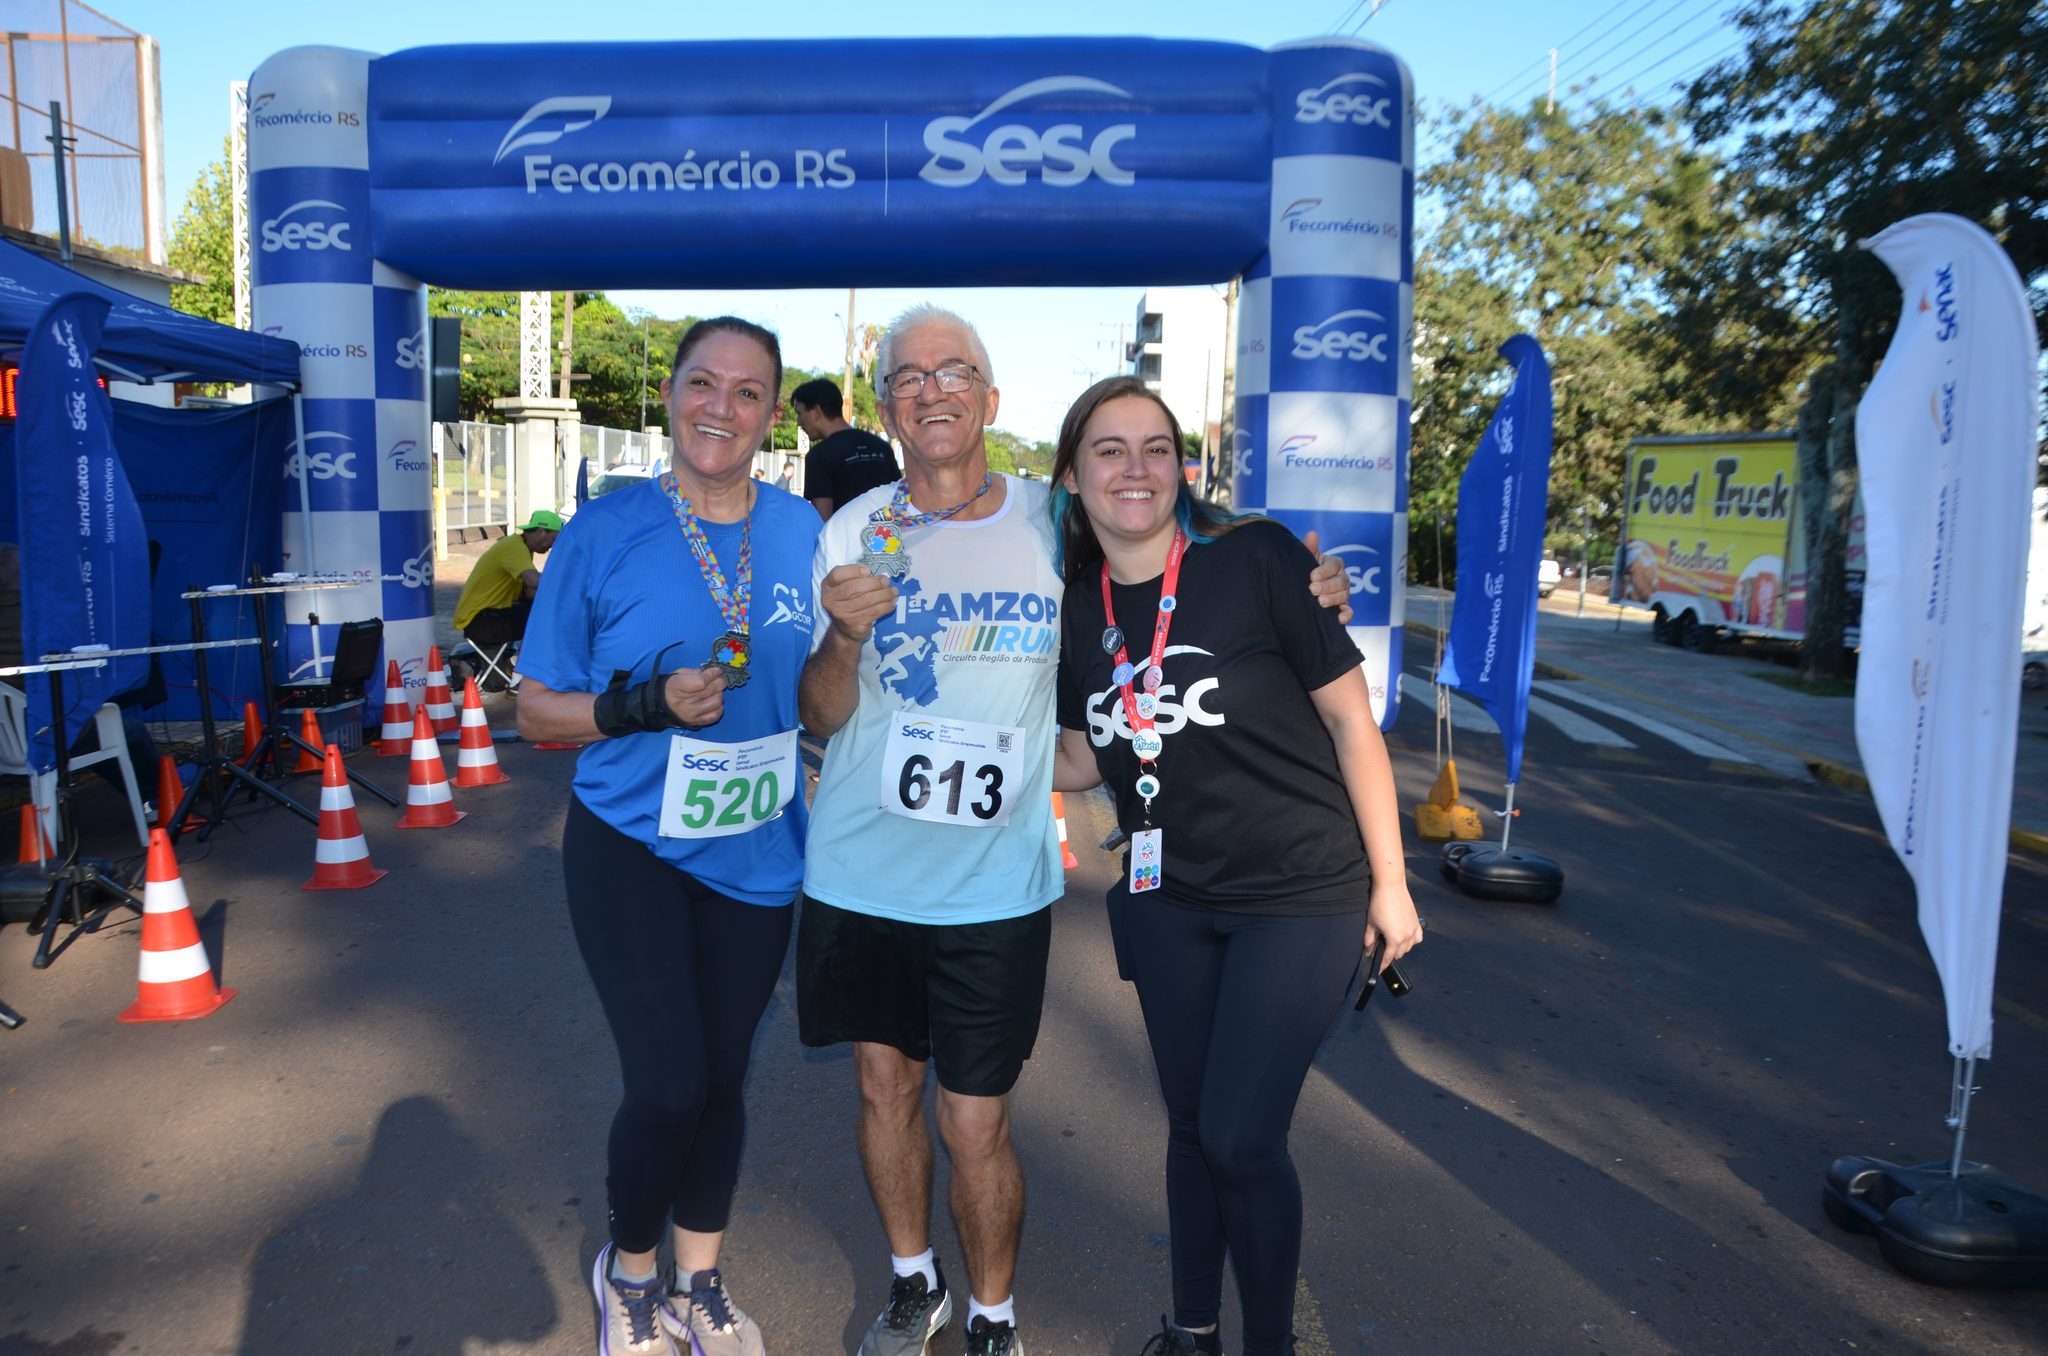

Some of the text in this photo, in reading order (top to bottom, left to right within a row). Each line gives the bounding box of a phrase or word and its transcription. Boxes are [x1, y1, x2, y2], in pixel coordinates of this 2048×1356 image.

[255, 110, 360, 128] Fecomércio RS
[1294, 87, 1391, 129] Sesc
[524, 148, 855, 193] Fecomércio RS
[918, 114, 1136, 188] Sesc
[262, 218, 351, 252] Sesc
[1289, 218, 1398, 238] Fecomércio RS
[345, 344, 368, 358] RS
[1291, 324, 1387, 363] Sesc
[71, 391, 87, 431] Sesc
[1500, 415, 1513, 455] Sesc
[1286, 454, 1393, 471] Fecomércio RS
[77, 455, 91, 537] Sindicatos
[103, 457, 116, 544] Sistema Comércio
[1633, 456, 1789, 520] Food Truck
[1497, 474, 1513, 553] Sindicatos
[933, 591, 1058, 625] AMZOP
[1479, 573, 1505, 683] Fecomércio RS
[943, 654, 977, 662] Circuito
[979, 654, 1010, 663] Região
[1012, 655, 1022, 663] da
[994, 625, 1057, 655] RUN
[1087, 675, 1226, 748] Sesc
[902, 724, 935, 741] Sesc
[682, 753, 730, 772] Sesc
[680, 771, 779, 830] 520
[898, 754, 1004, 820] 613
